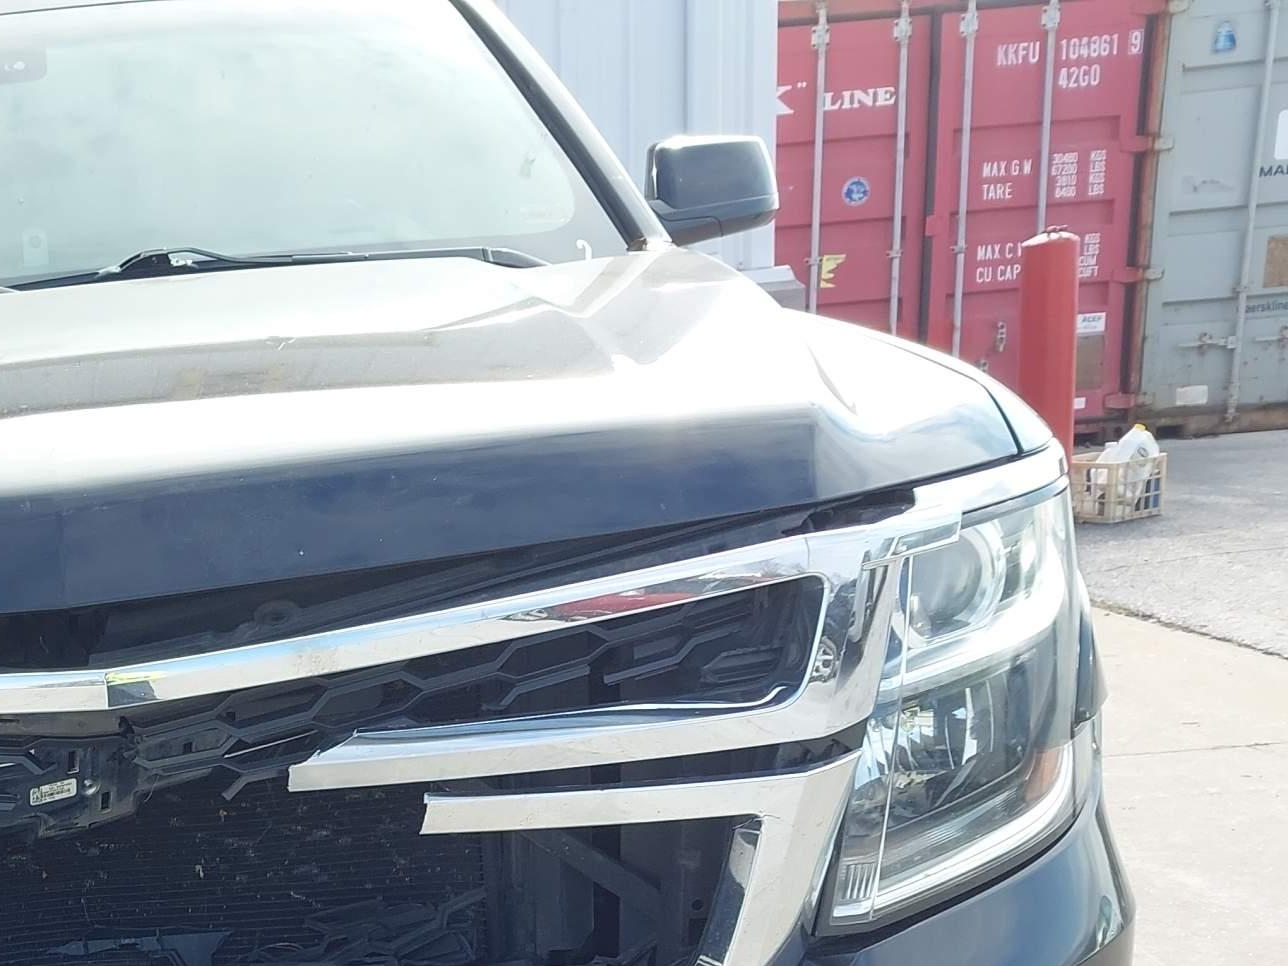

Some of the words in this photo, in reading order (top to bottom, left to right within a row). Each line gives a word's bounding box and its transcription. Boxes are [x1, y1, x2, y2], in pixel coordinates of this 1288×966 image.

[997, 41, 1040, 66] KKFU
[1060, 33, 1119, 60] 104861
[1129, 30, 1143, 55] 9
[823, 87, 896, 111] LINE
[982, 160, 1007, 177] MAX
[1090, 160, 1106, 172] LBS
[982, 182, 1013, 200] TARE
[1088, 183, 1104, 195] LBS
[976, 243, 1000, 261] MAX
[1083, 243, 1100, 256] LBS
[976, 266, 992, 283] CU
[998, 263, 1021, 281] CAP
